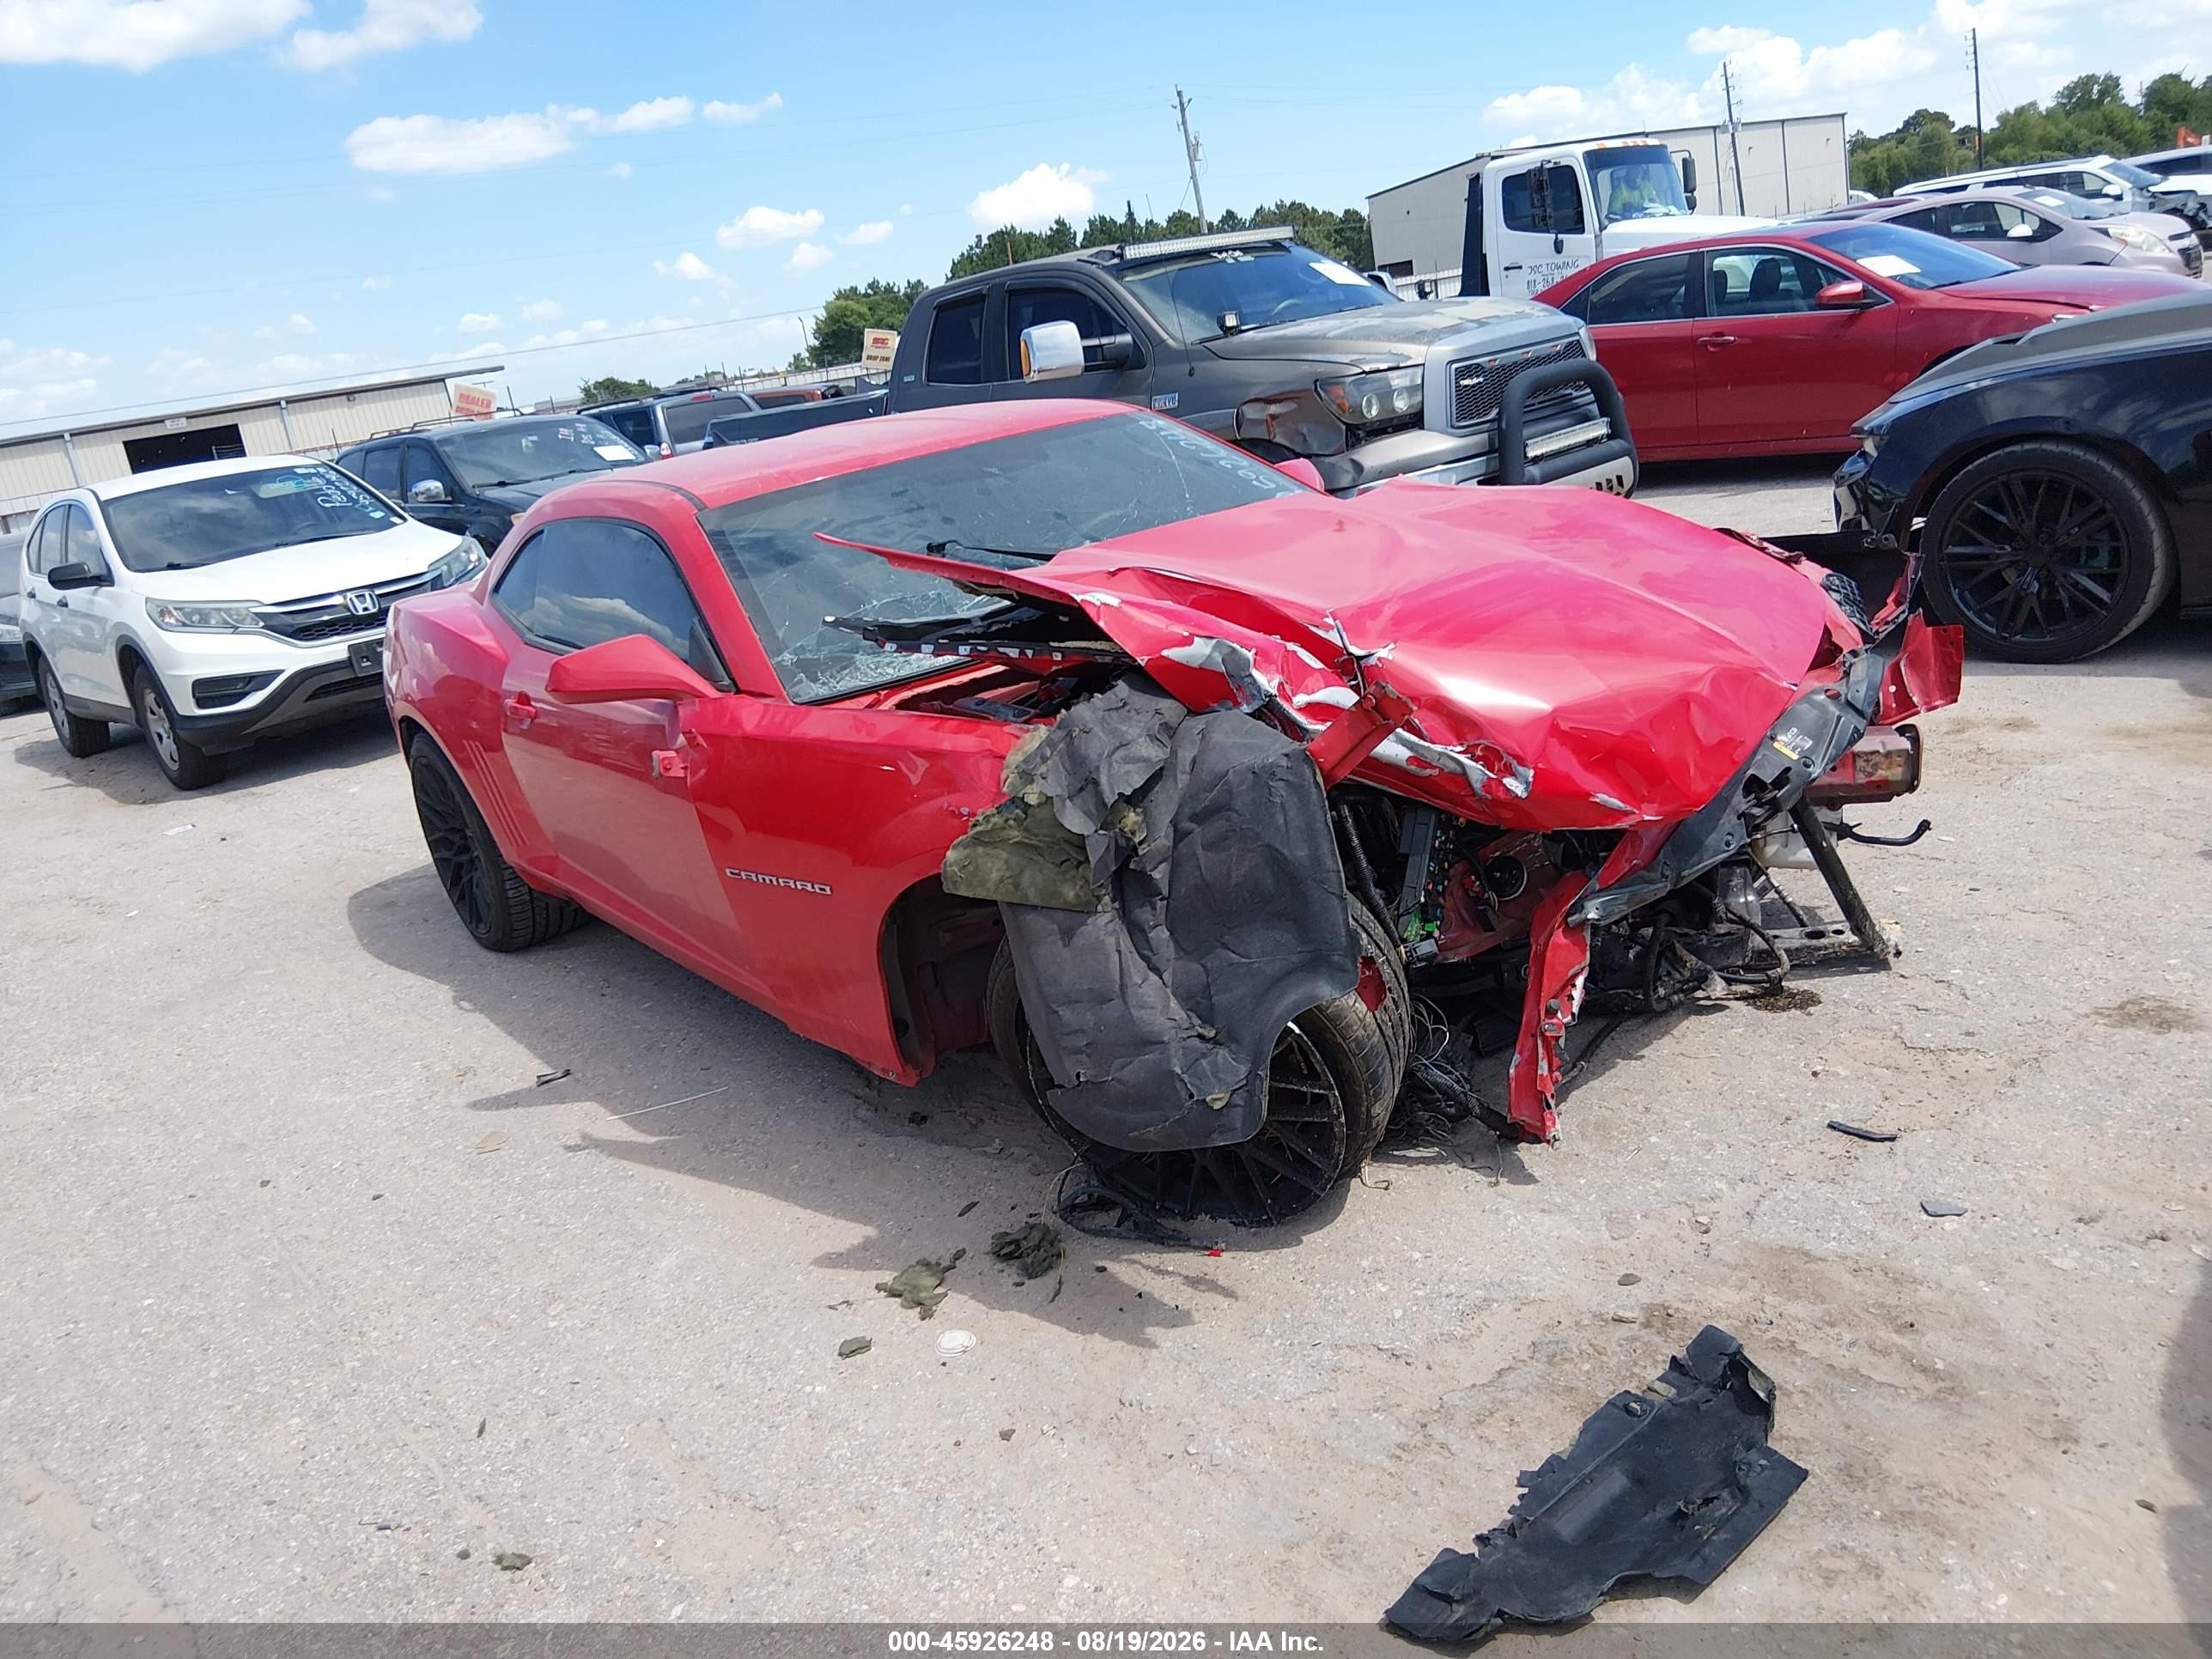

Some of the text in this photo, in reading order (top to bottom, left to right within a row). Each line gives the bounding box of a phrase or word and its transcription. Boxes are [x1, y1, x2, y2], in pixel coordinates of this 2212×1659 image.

[1546, 259, 1579, 272] TOWING
[459, 392, 492, 408] DEALER
[725, 867, 832, 895] CAMARO
